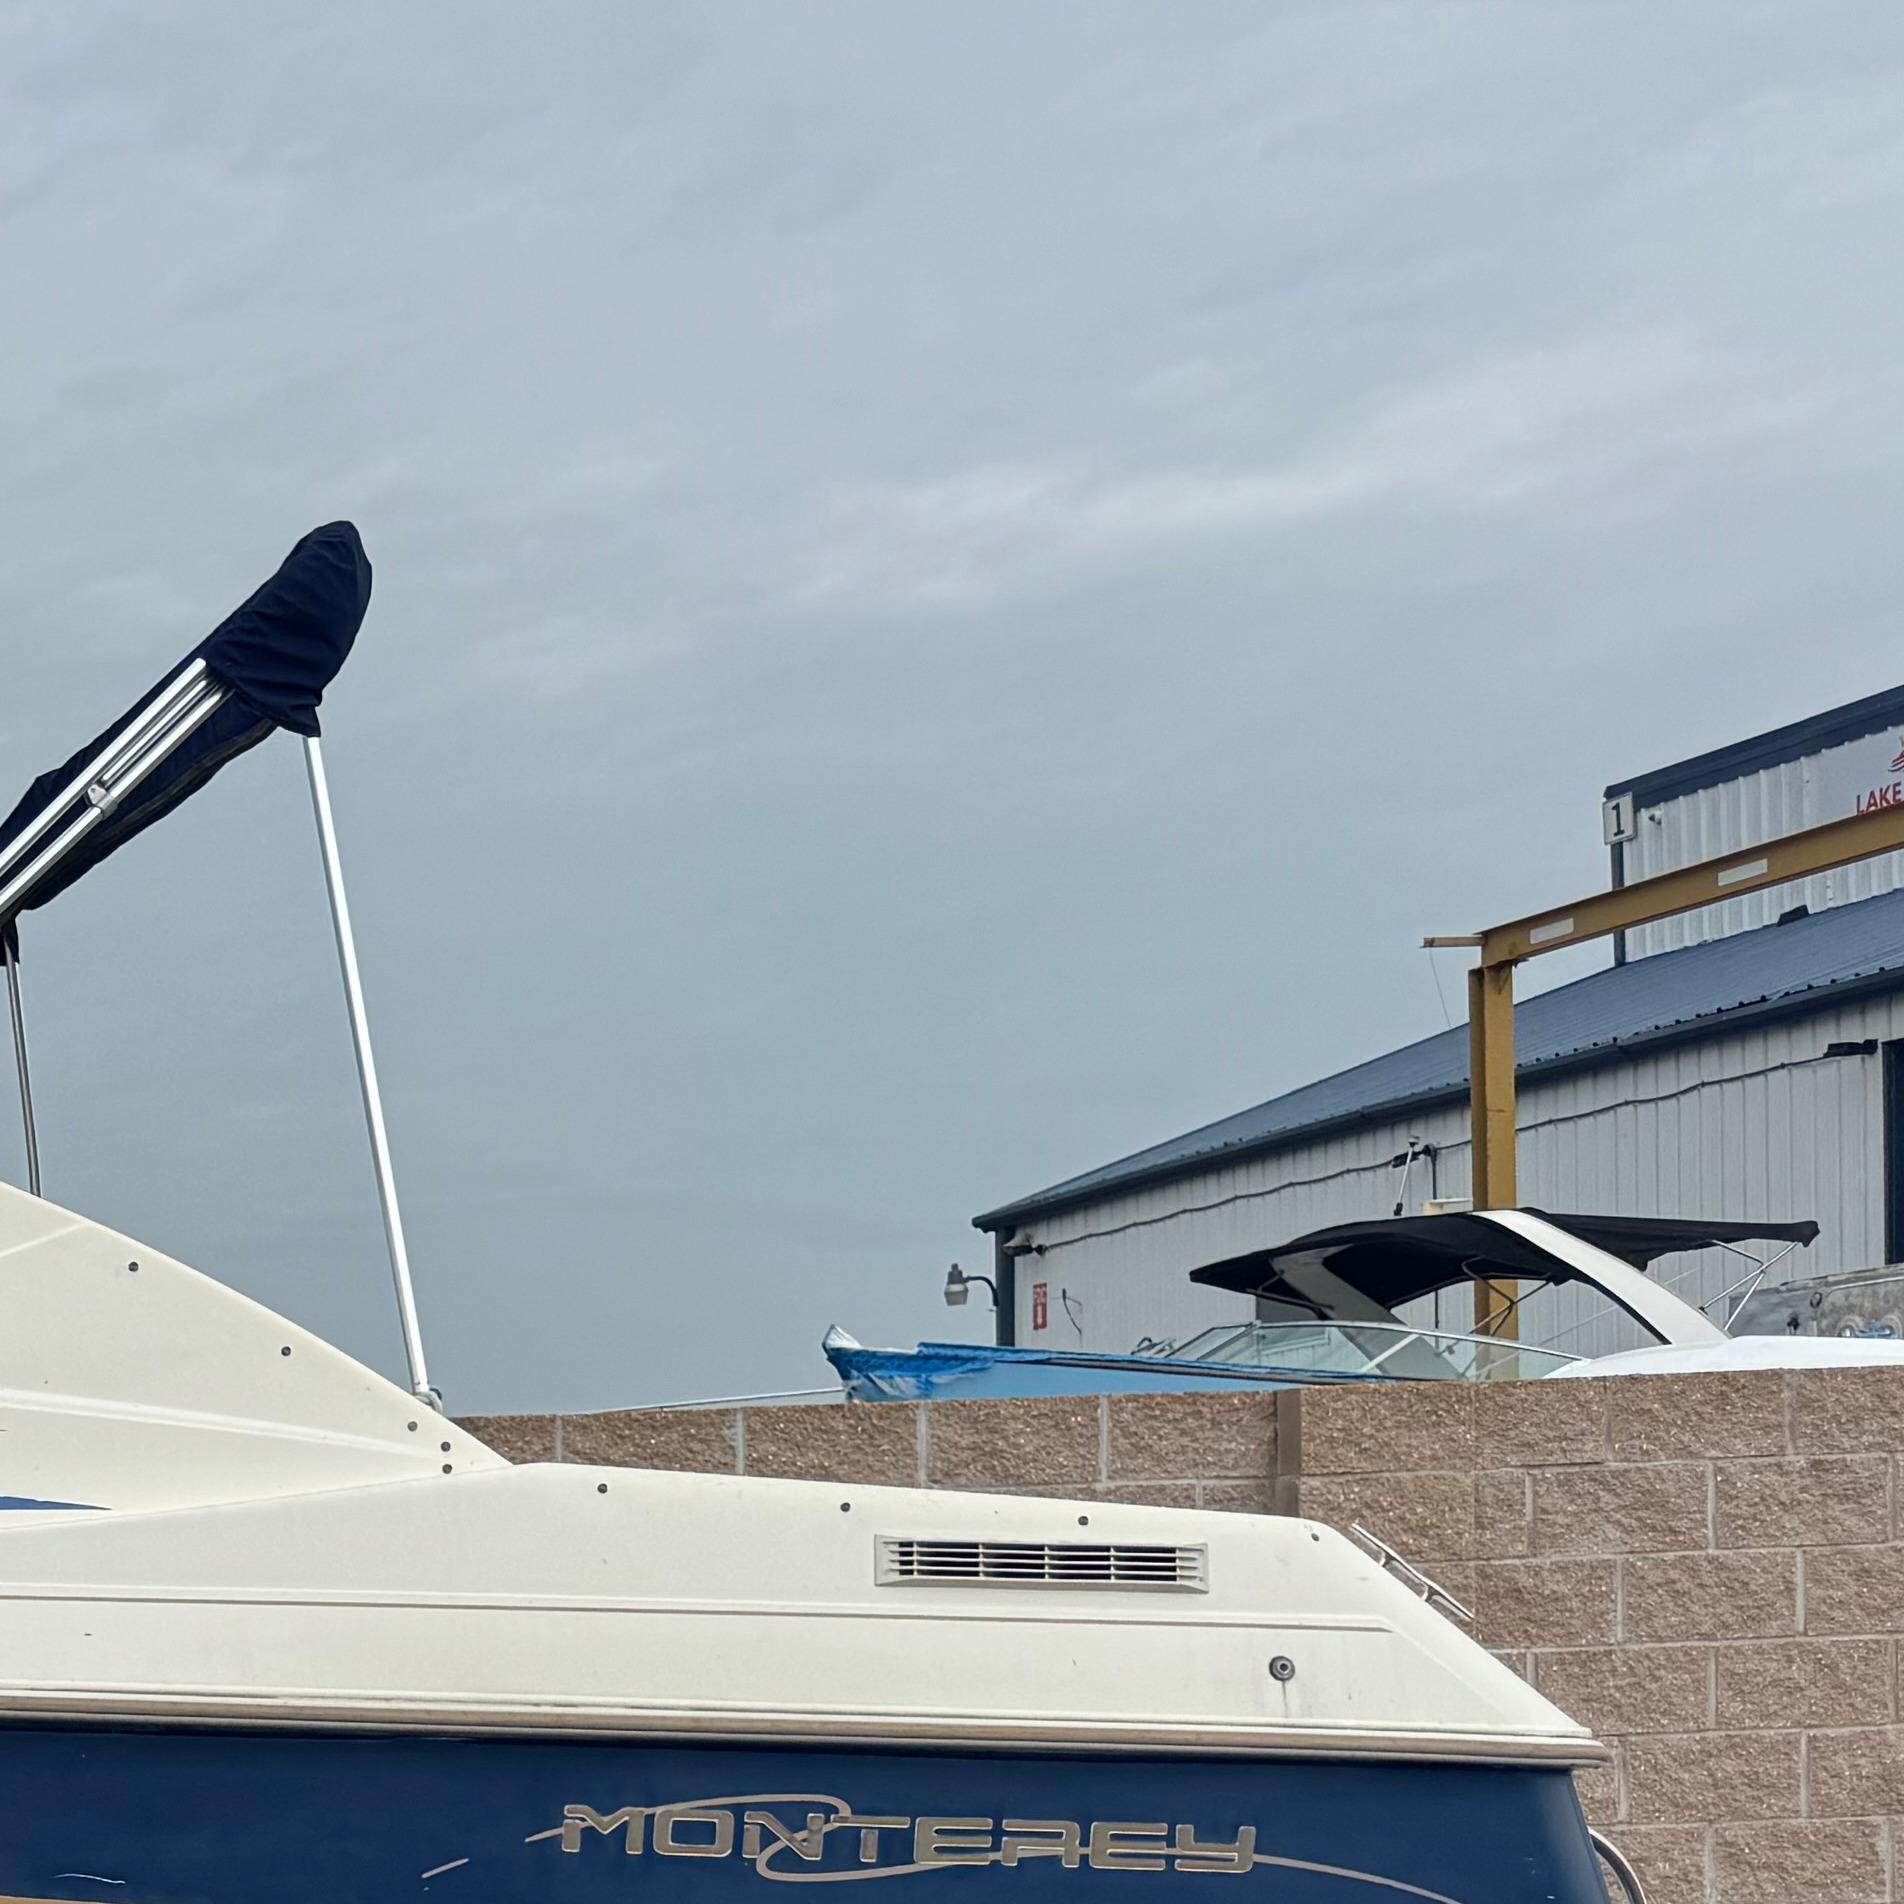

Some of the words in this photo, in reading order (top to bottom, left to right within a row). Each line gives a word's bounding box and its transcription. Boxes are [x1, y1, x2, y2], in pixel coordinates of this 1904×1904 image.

[1856, 782, 1902, 816] LAKE
[1610, 803, 1625, 836] 1
[561, 1804, 1257, 1874] MONTEREY
